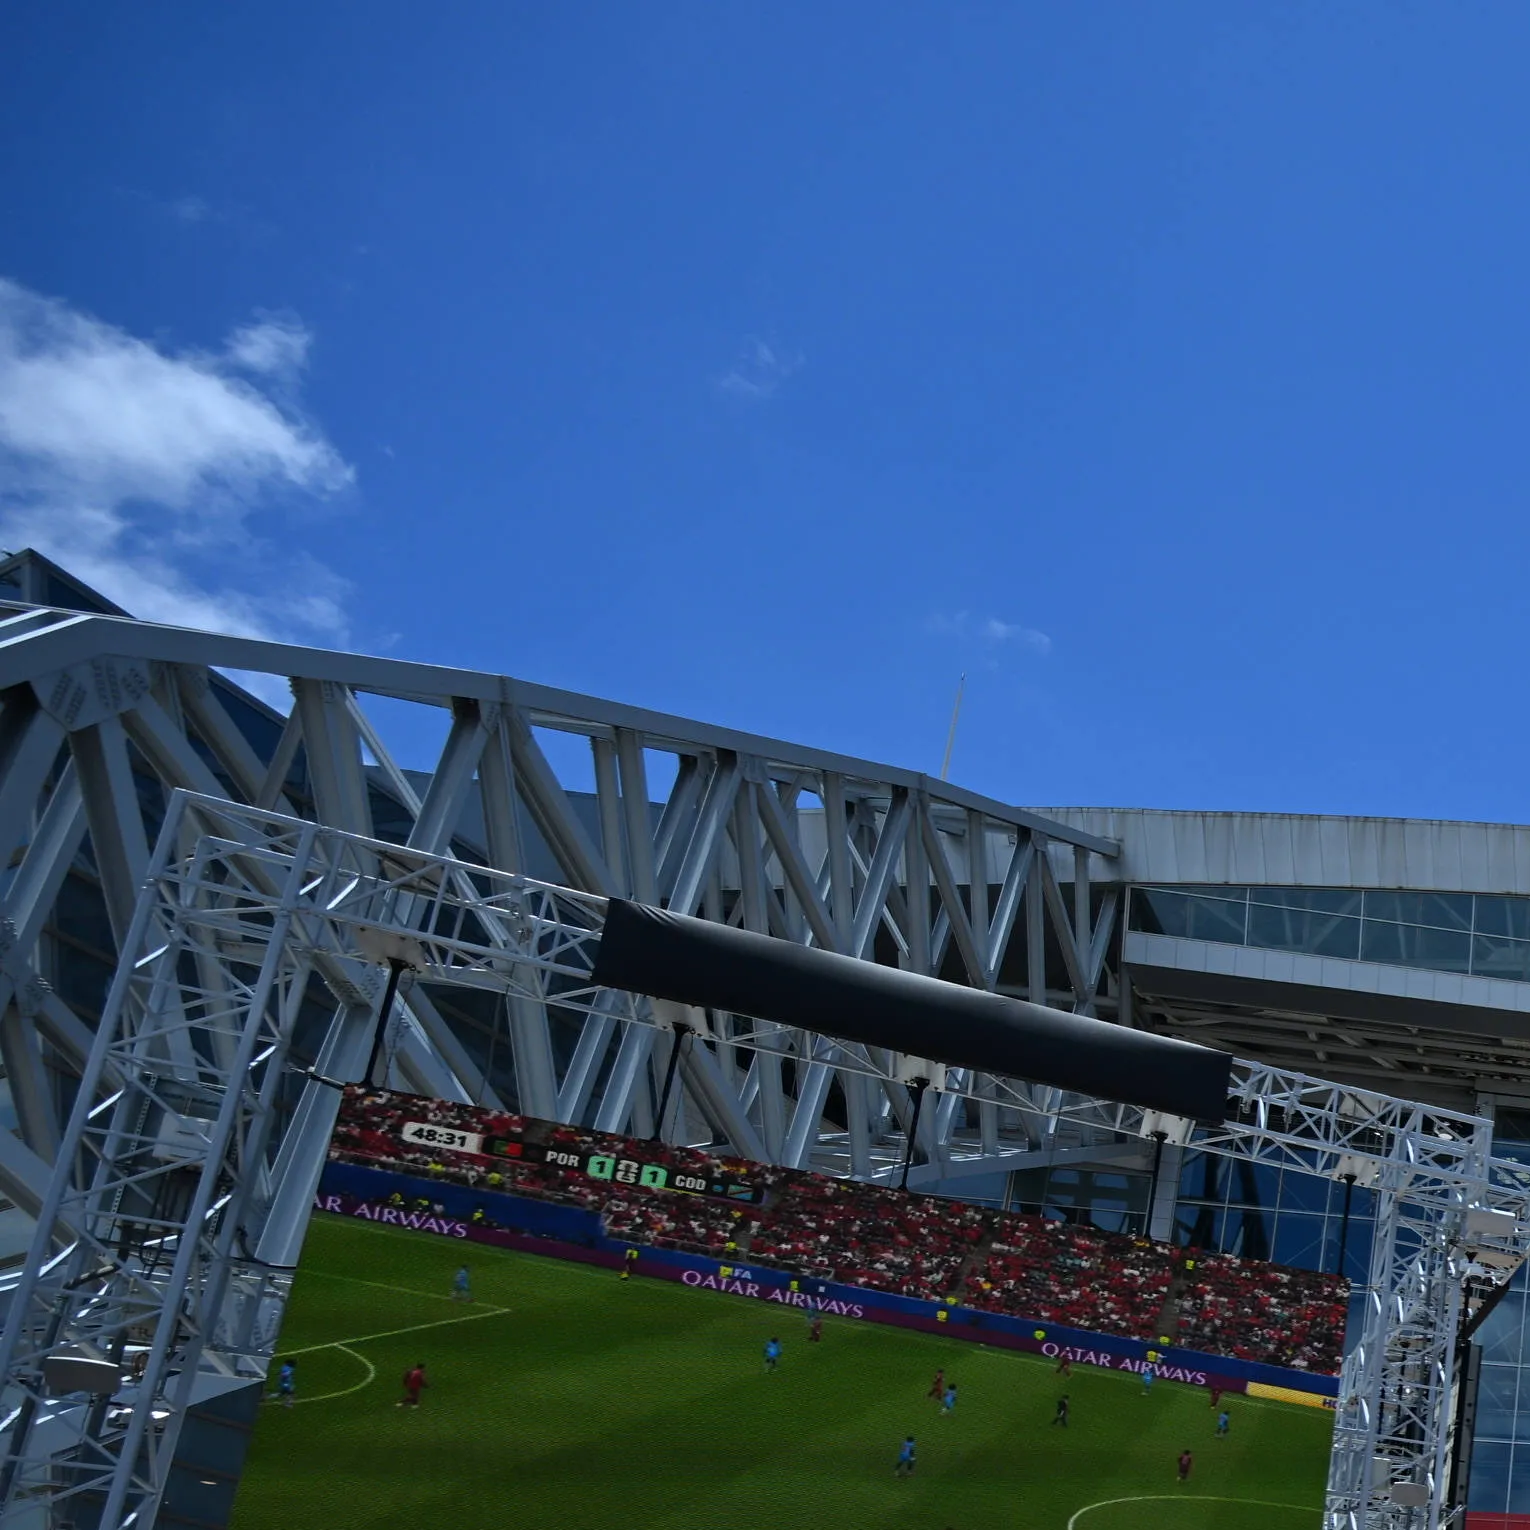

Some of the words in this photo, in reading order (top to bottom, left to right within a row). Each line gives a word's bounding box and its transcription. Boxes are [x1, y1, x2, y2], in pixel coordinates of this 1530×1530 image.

[411, 1127, 467, 1147] 48:31
[546, 1150, 579, 1167] POR
[354, 1203, 468, 1238] AIRWAYS
[682, 1270, 760, 1298] QATAR
[768, 1289, 864, 1318] AIRWAYS
[1041, 1342, 1111, 1367] QATAR
[1119, 1359, 1207, 1386] AIRWAYS
